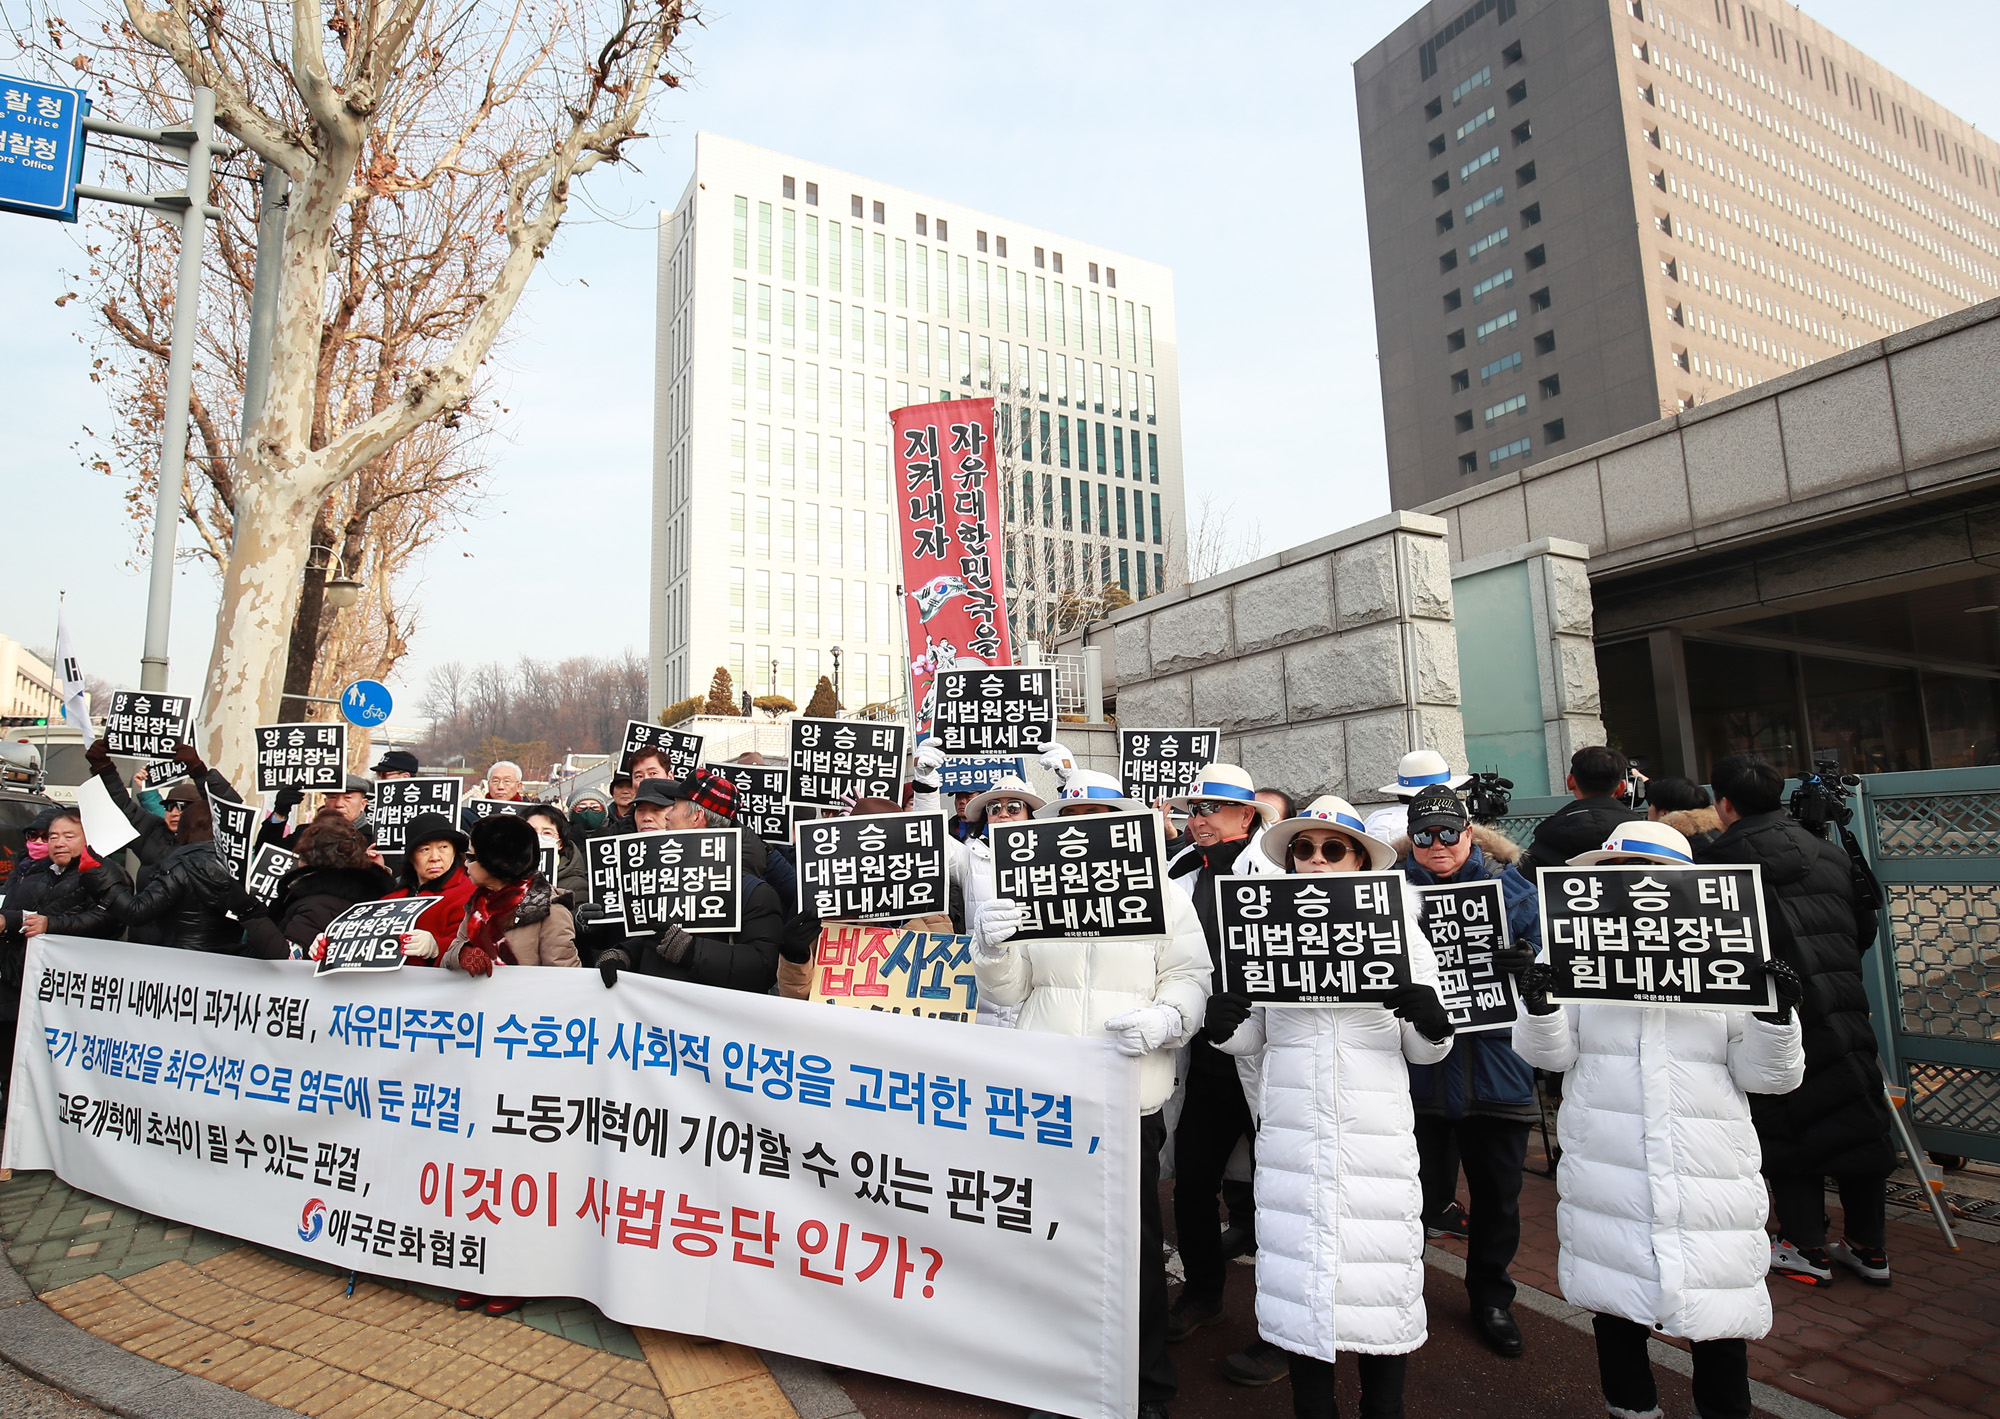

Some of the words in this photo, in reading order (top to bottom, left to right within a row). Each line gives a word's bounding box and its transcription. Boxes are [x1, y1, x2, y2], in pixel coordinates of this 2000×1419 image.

[17, 114, 59, 129] Office
[22, 158, 54, 171] Office
[903, 425, 950, 560] 지켜내자
[950, 421, 998, 659] 자유대한민국을
[108, 713, 184, 737] 대법원장님
[937, 698, 1049, 724] 대법원장님
[107, 732, 177, 755] 힘내세요
[943, 725, 1043, 749] 힘내세요
[259, 747, 340, 767] 대법원장님
[793, 750, 898, 778] 대법원장님
[263, 767, 336, 787] 힘내세요
[799, 774, 890, 800] 힘내세요
[623, 865, 732, 897] 대법원장님
[805, 850, 940, 887] 대법원장님
[1000, 857, 1154, 898] 대법원장님
[630, 895, 727, 925] 힘내세요
[814, 882, 935, 919] 힘내세요
[1016, 895, 1152, 931] 힘내세요
[327, 914, 411, 940] 대법원장님
[1064, 930, 1100, 938] 애국문화협회
[1228, 919, 1401, 957] 대법원장님
[1552, 916, 1755, 954] 대법원장님
[325, 939, 399, 966] 힘내세요
[1461, 895, 1507, 1011] 힘내세요
[1241, 960, 1399, 994] 힘내세요
[1568, 955, 1751, 994] 힘내세요
[1633, 993, 1681, 1003] 애국문화협회
[38, 967, 87, 1009] 합리적
[90, 974, 125, 1014] 범위
[127, 980, 199, 1025] 내에서의
[203, 988, 261, 1034] 과거사
[266, 994, 318, 1044] 정립,
[328, 1002, 484, 1058] 자유민주주의
[493, 1013, 599, 1065] 수호와
[607, 1021, 711, 1084] 사회적
[722, 1040, 836, 1108] 안정을
[845, 1063, 972, 1131] 고려한
[58, 1091, 142, 1146] 교육개혁에
[146, 1111, 201, 1160] 초석이
[207, 1122, 229, 1165] 될
[234, 1128, 258, 1169] 수
[263, 1133, 309, 1181] 있는
[313, 1140, 371, 1198] 판결,
[81, 1033, 163, 1085] 경제발전을
[298, 1068, 372, 1119] 염두에
[377, 1079, 405, 1123] 둔
[410, 1082, 476, 1139] 판결,
[491, 1093, 669, 1159] 노동개혁에
[678, 1115, 792, 1180] 기여할
[801, 1141, 840, 1189] 수
[850, 1151, 933, 1214] 있는
[946, 1167, 1059, 1240] 판결,
[419, 1160, 558, 1228] 이것이
[328, 1208, 487, 1275] 애국문화협회
